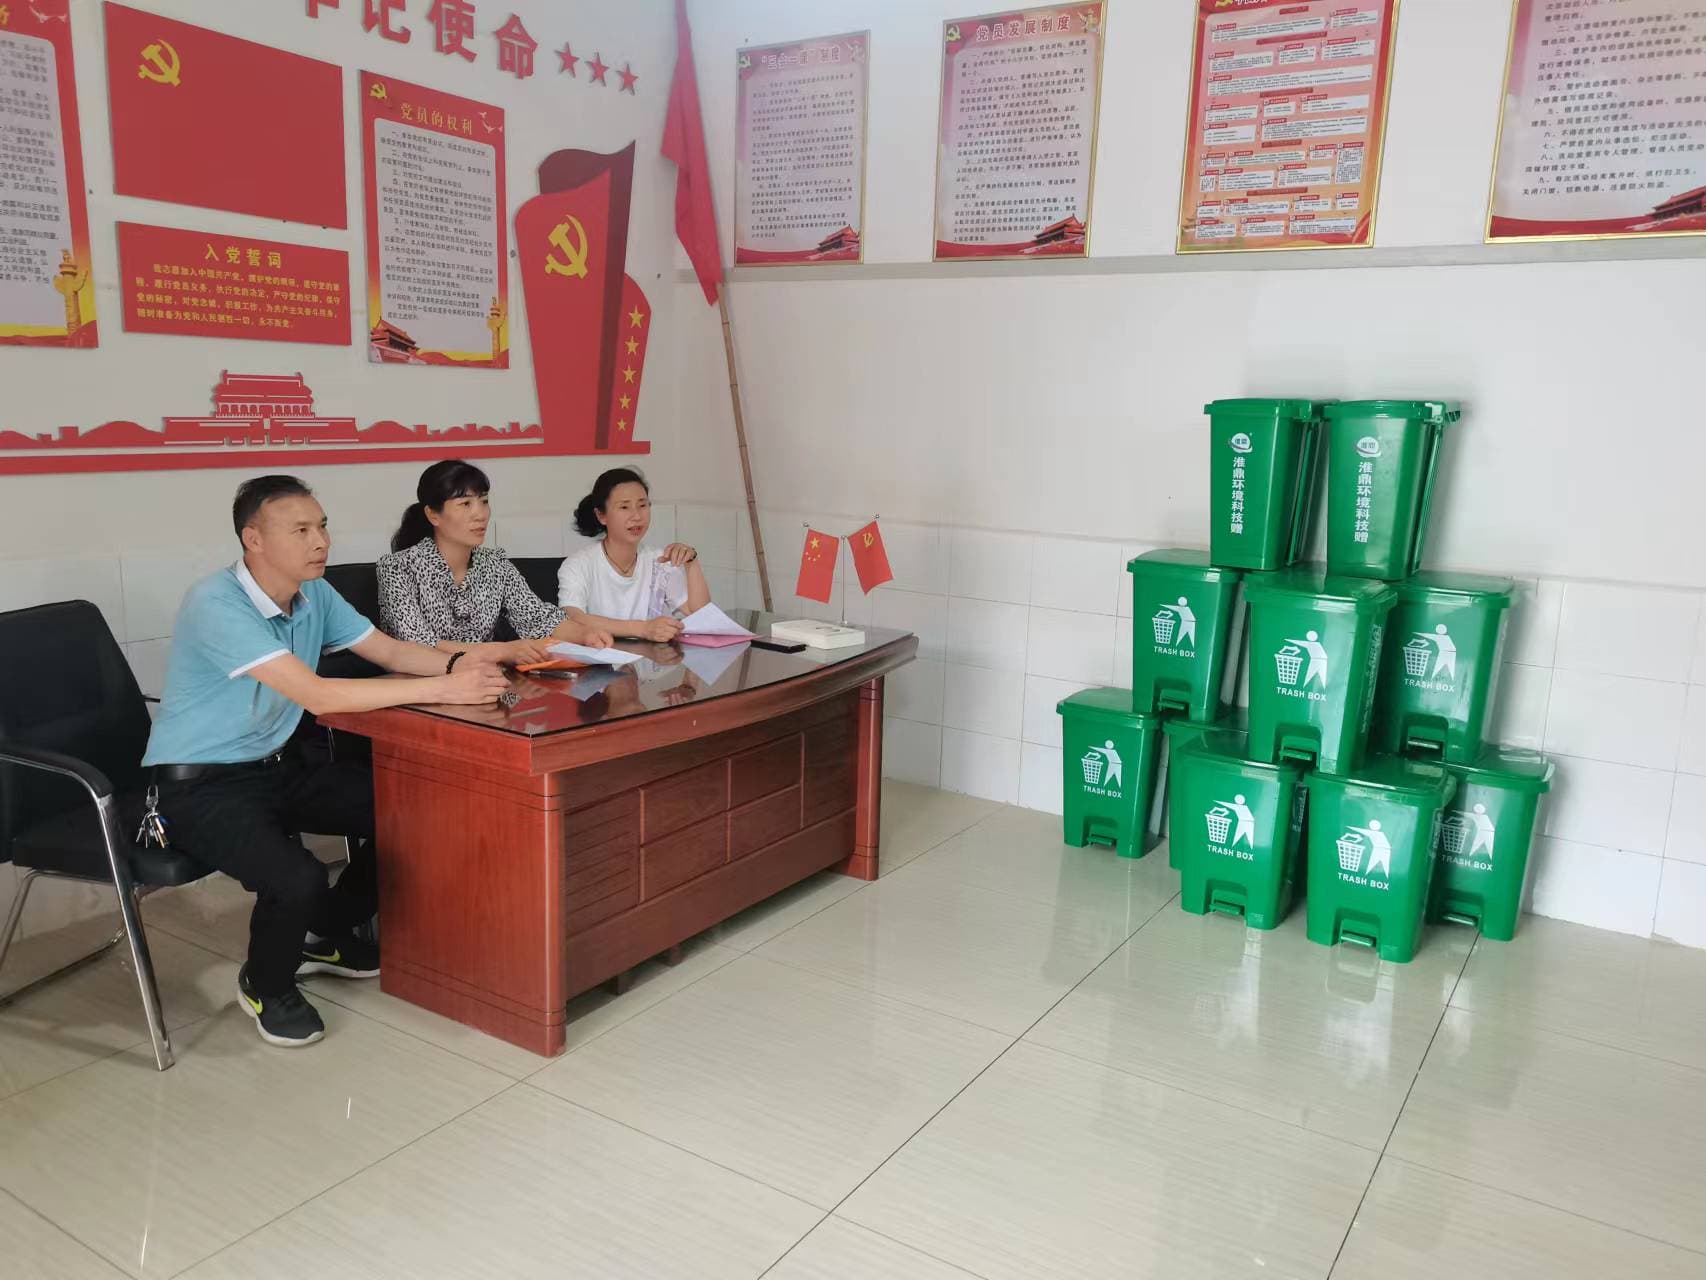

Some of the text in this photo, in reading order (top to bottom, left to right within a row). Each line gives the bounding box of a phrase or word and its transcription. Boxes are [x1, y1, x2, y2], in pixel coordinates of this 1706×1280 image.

[976, 15, 1073, 41] 党员发展制度
[304, 0, 539, 80] 记使命
[400, 102, 473, 136] 党员的权利
[204, 243, 282, 269] 入党誓词
[1230, 456, 1247, 535] 淮鼎环境科技赠
[1353, 461, 1373, 543] 淮鼎环境科技赠
[1153, 646, 1195, 658] TRASH BOX
[1276, 686, 1327, 701] TRASH BOX
[1404, 679, 1455, 693] TRASH BOX
[1083, 785, 1122, 798] TRASH BOX
[1207, 844, 1254, 861] TRASH BOX
[1441, 854, 1493, 872] TRASH BOX
[1337, 872, 1390, 891] TRASH BOX
